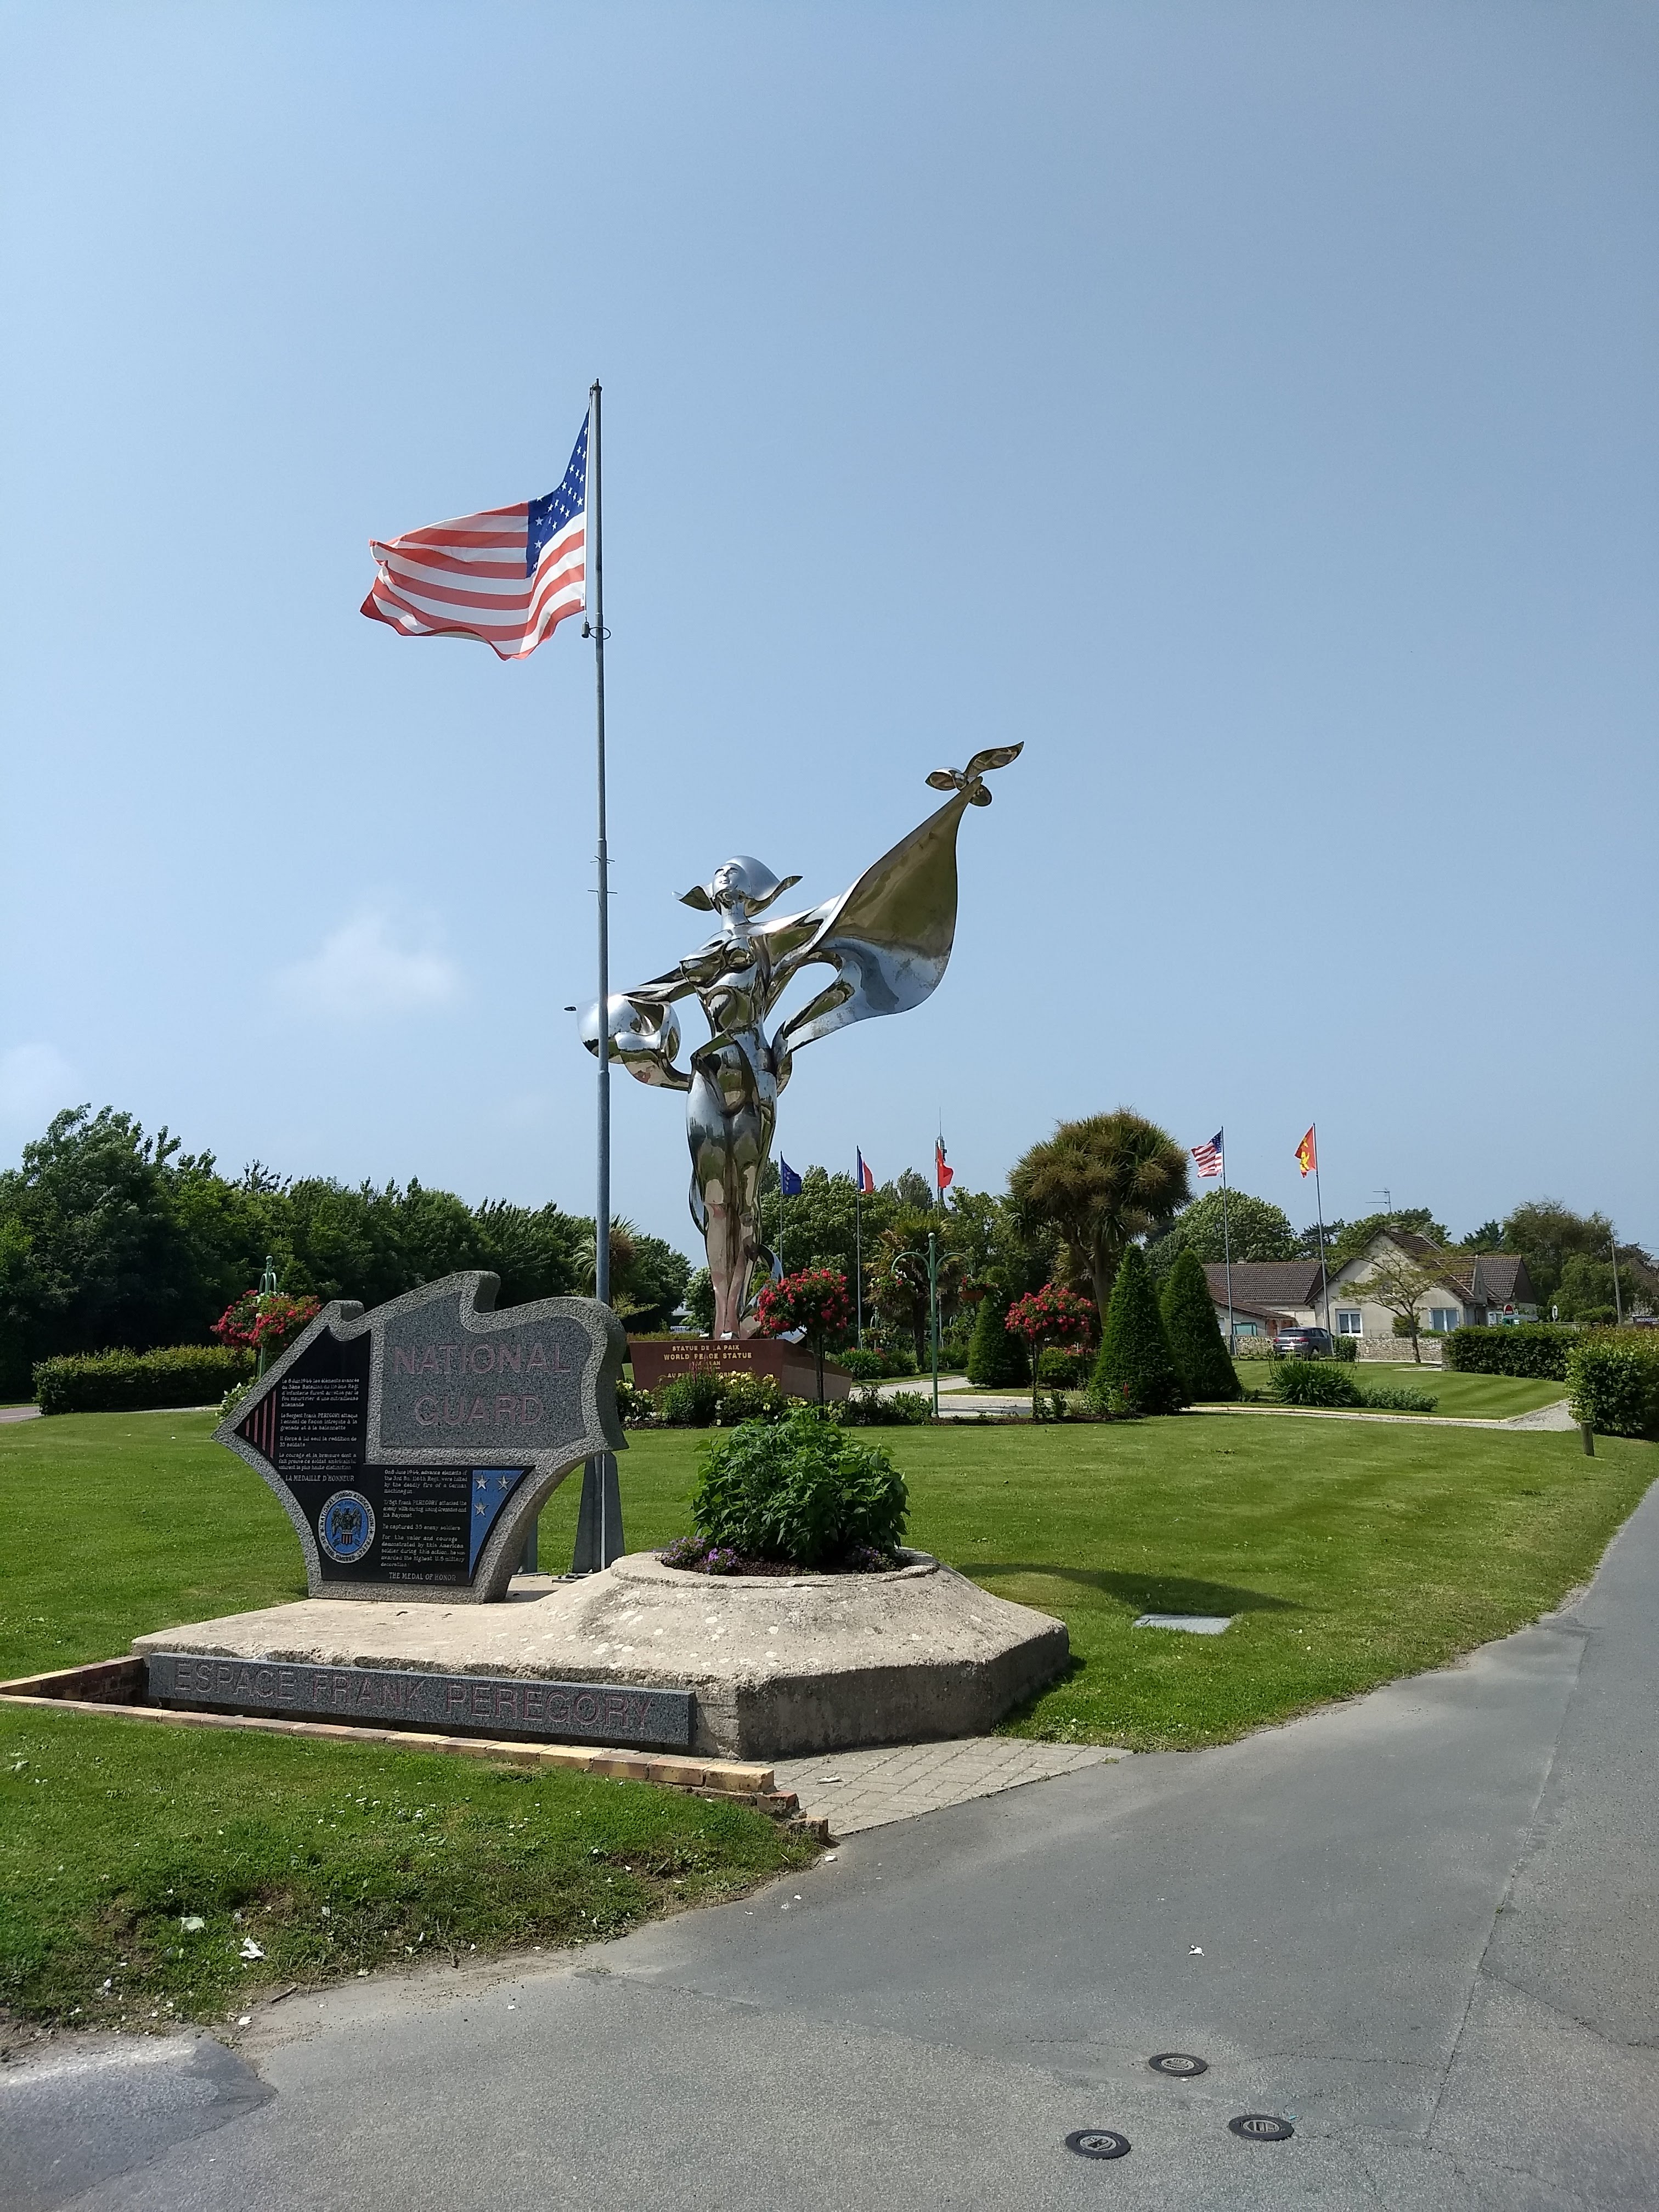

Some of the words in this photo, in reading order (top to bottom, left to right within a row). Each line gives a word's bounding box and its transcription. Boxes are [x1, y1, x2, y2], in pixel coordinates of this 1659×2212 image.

[393, 1343, 571, 1374] NATIONAL
[415, 1394, 544, 1425] GUARD
[320, 1498, 335, 1526] NATIONAL
[174, 1660, 295, 1701] ESPACE
[312, 1674, 428, 1713] FRANK
[445, 1681, 652, 1730] PEREGORY
